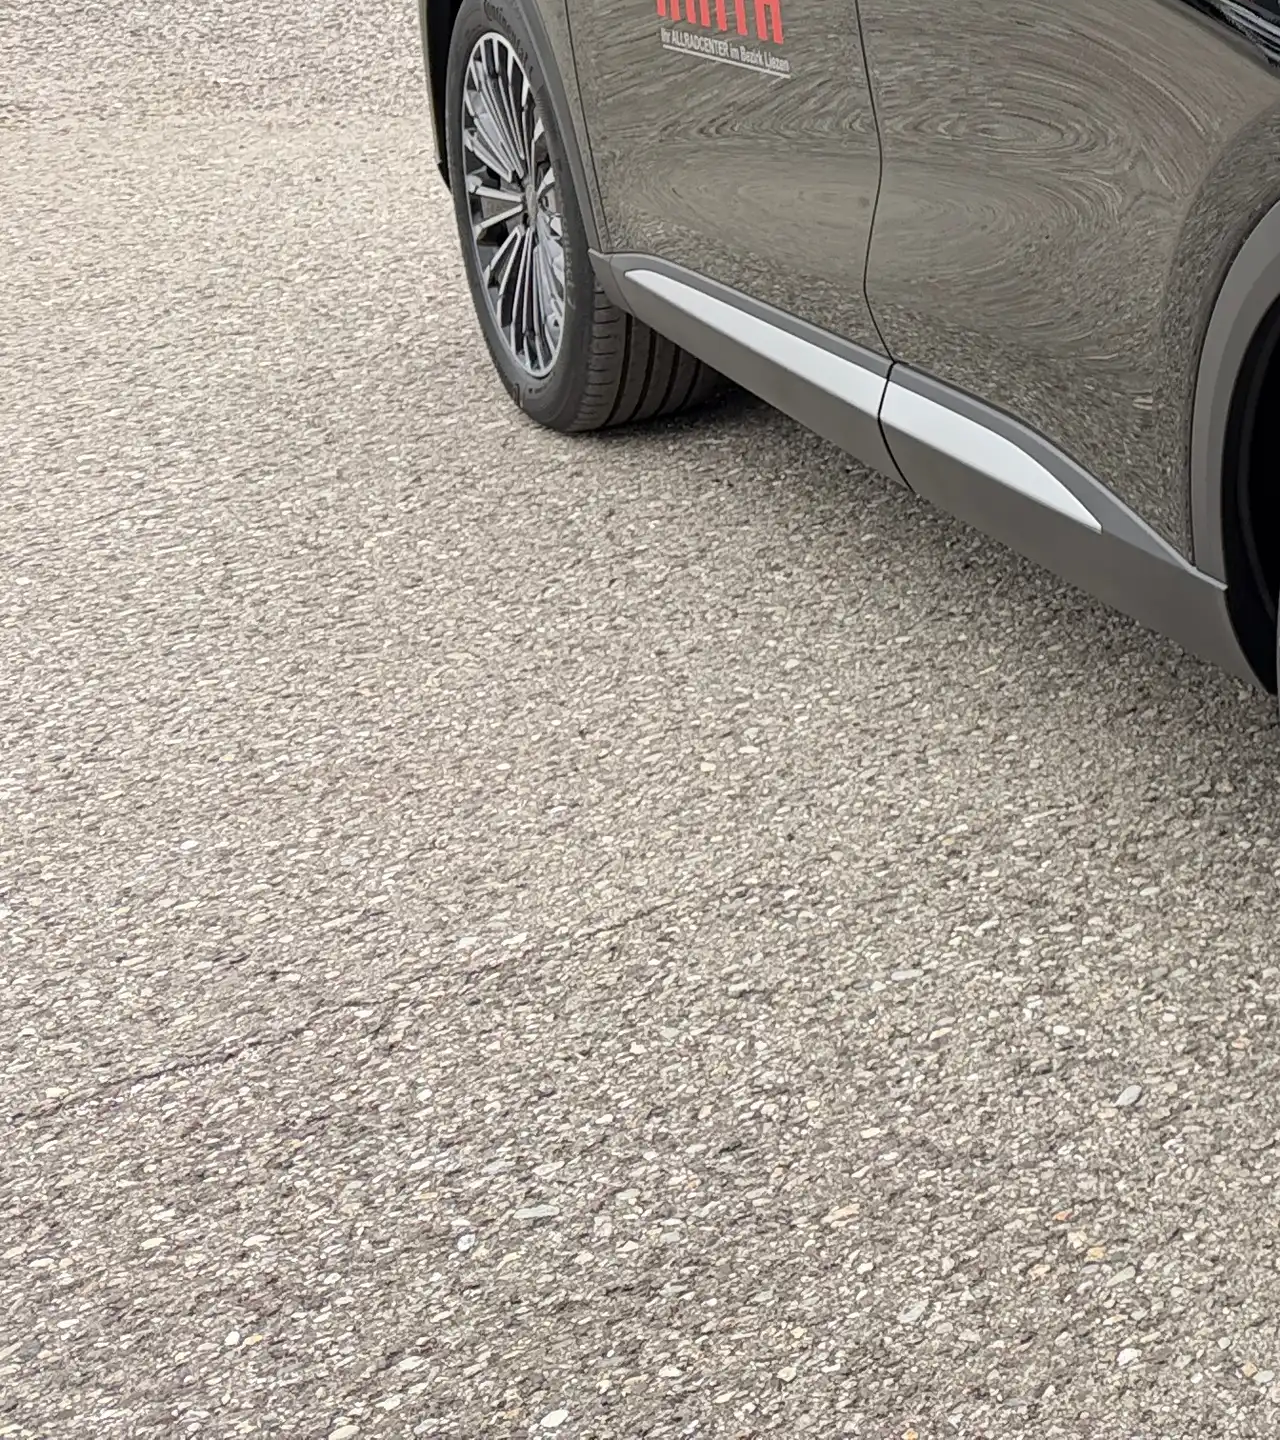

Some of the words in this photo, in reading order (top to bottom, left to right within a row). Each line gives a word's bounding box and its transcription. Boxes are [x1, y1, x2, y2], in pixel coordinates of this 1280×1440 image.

[671, 30, 730, 59] ALLRADCENTER
[730, 42, 740, 61] im
[740, 45, 763, 67] Bezirk
[763, 50, 790, 73] Liezen
